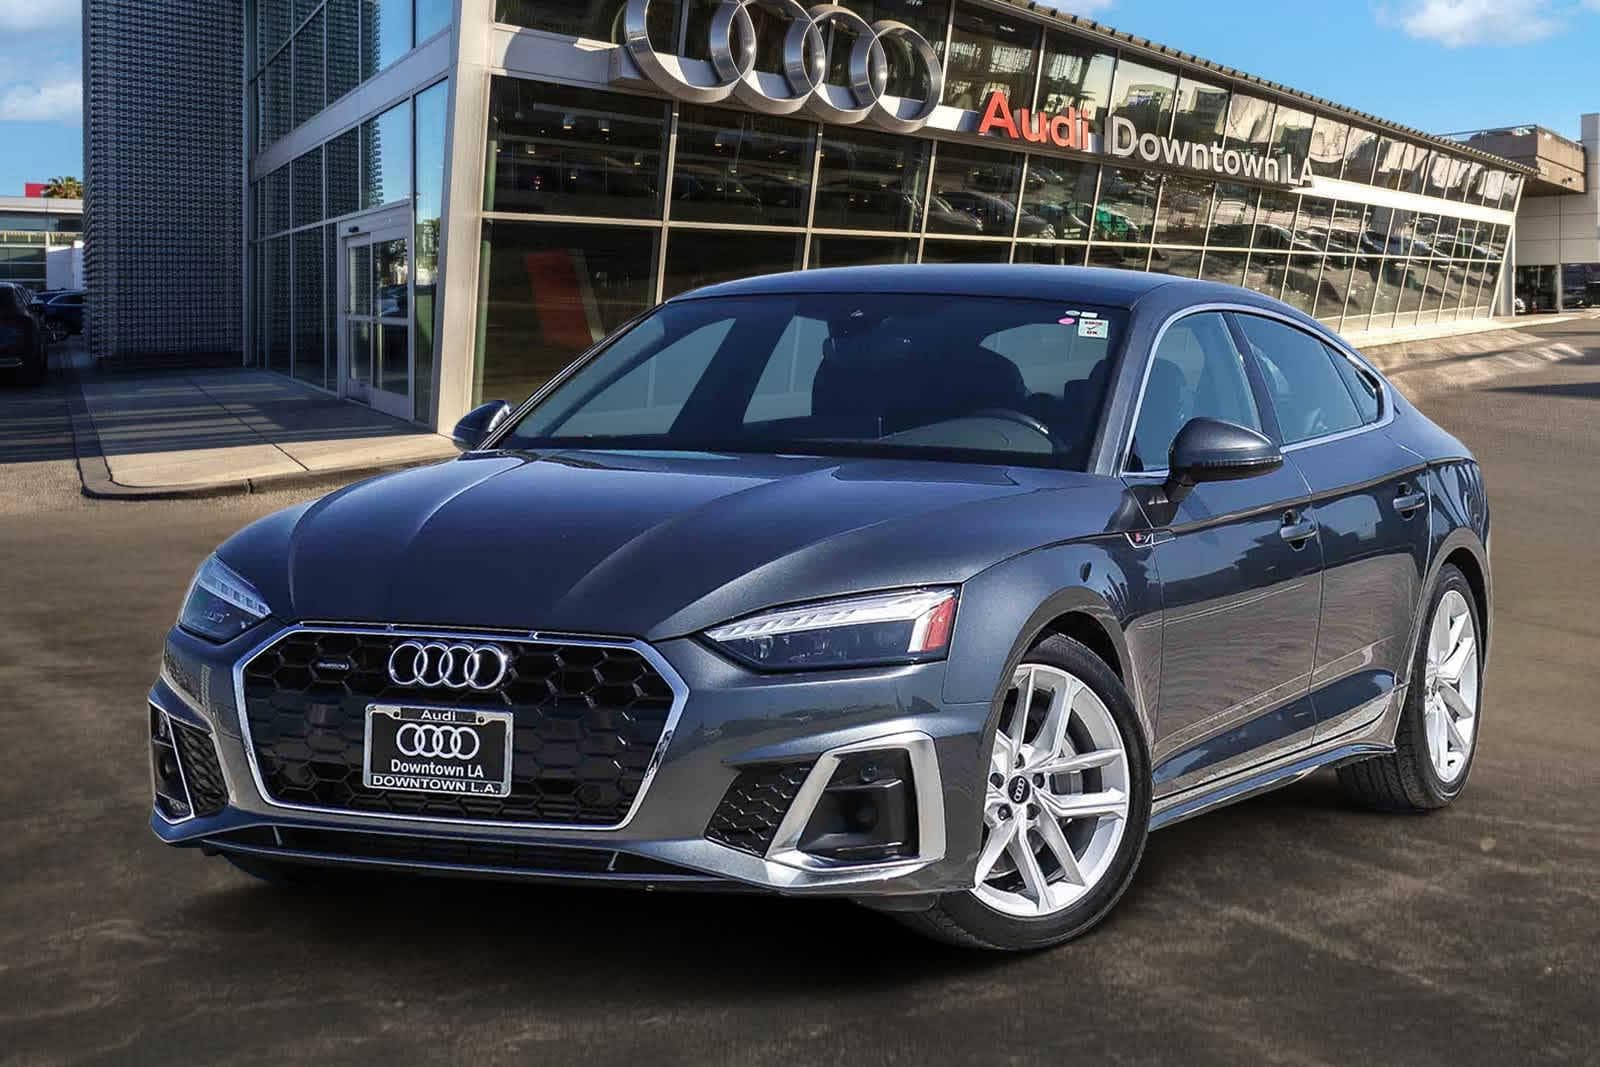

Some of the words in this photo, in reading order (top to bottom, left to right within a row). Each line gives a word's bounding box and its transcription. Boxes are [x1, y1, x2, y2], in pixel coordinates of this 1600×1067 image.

[978, 91, 1089, 150] Audi
[1106, 116, 1280, 184] Downtown
[1285, 153, 1315, 188] LA
[421, 709, 456, 721] Audi
[391, 759, 464, 777] Downtown
[467, 764, 484, 778] LA
[373, 775, 466, 791] DOWNTOWN
[471, 782, 499, 793] L.A.
